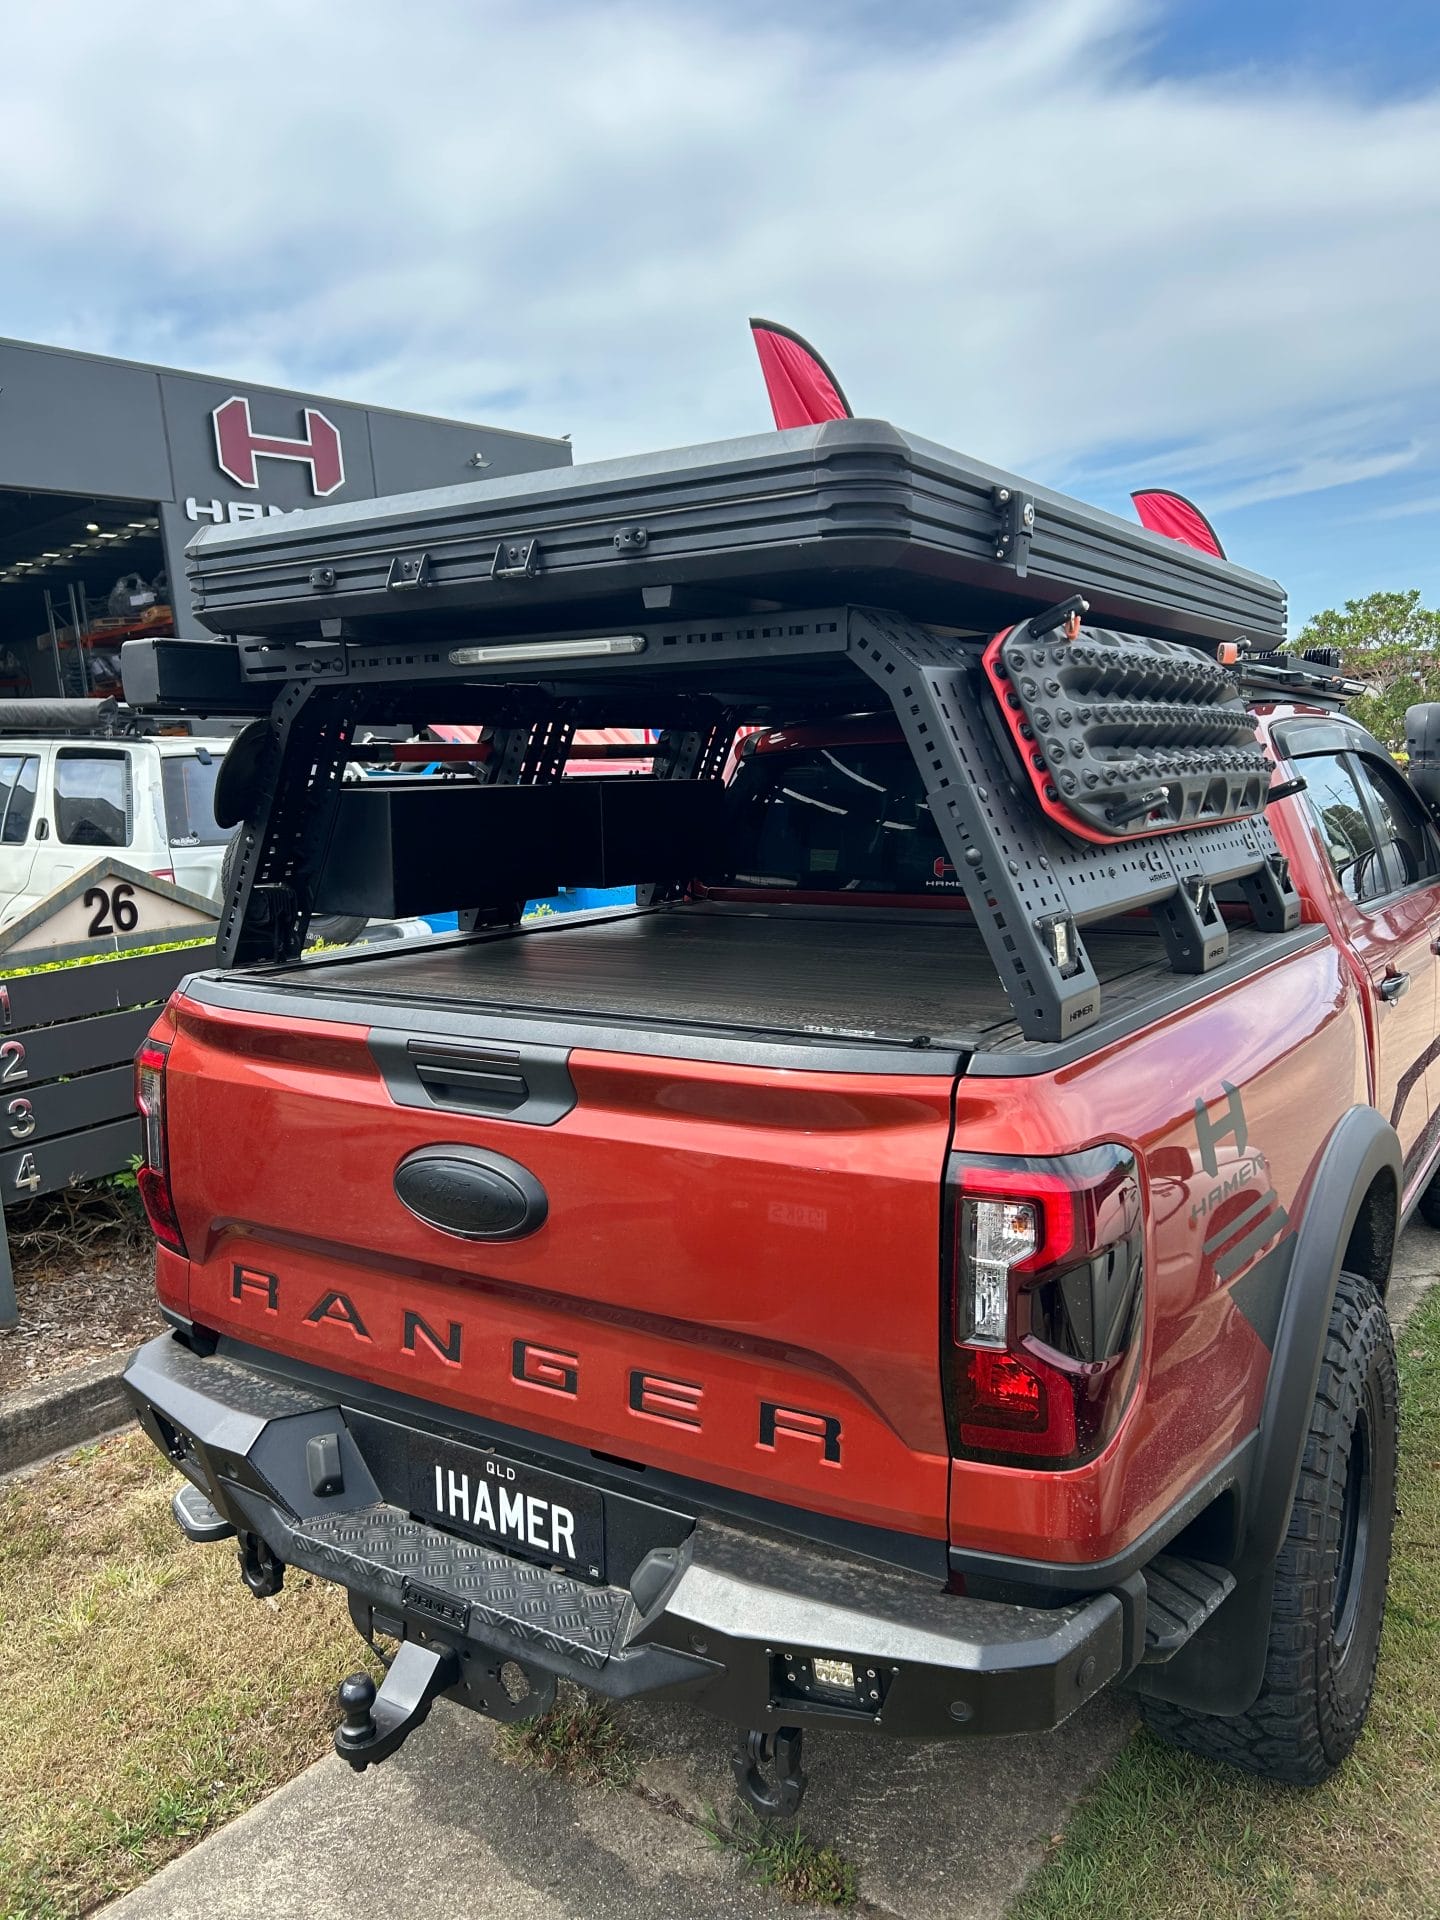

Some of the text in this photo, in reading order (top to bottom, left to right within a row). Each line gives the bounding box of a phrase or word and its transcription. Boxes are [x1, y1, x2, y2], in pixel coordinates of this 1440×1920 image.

[83, 884, 139, 938] 26
[0, 1040, 29, 1084] 2
[8, 1098, 37, 1139] 3
[15, 1152, 42, 1192] 4
[230, 1262, 844, 1468] RANGER
[486, 1461, 516, 1481] QLD
